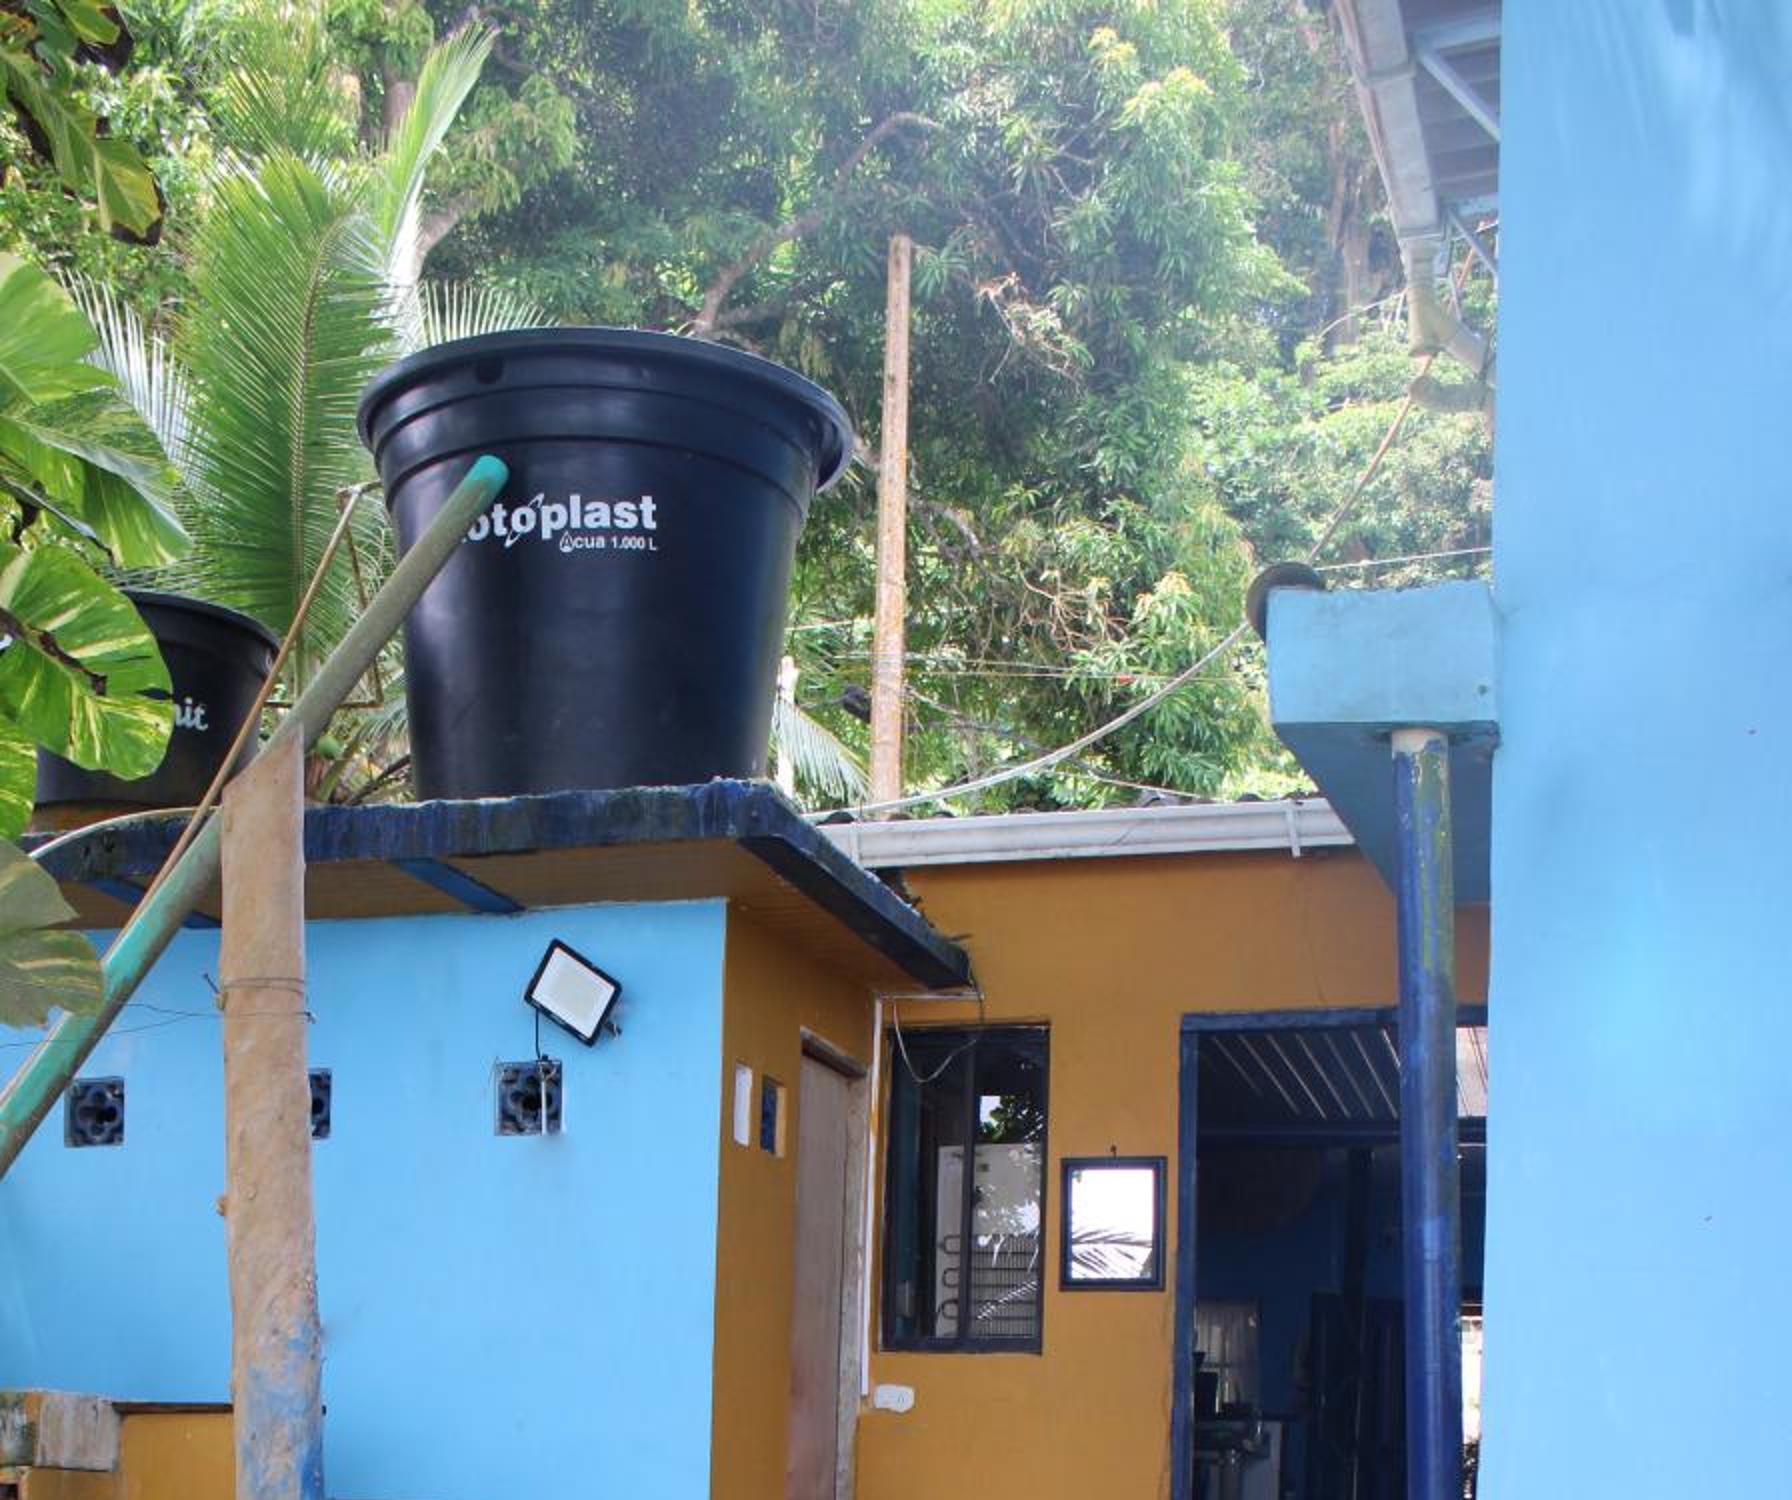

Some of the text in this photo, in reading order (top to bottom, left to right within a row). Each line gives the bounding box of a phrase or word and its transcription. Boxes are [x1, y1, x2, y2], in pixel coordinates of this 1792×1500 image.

[462, 493, 657, 547] otoplast
[611, 535, 645, 550] 1.000
[649, 536, 657, 551] L
